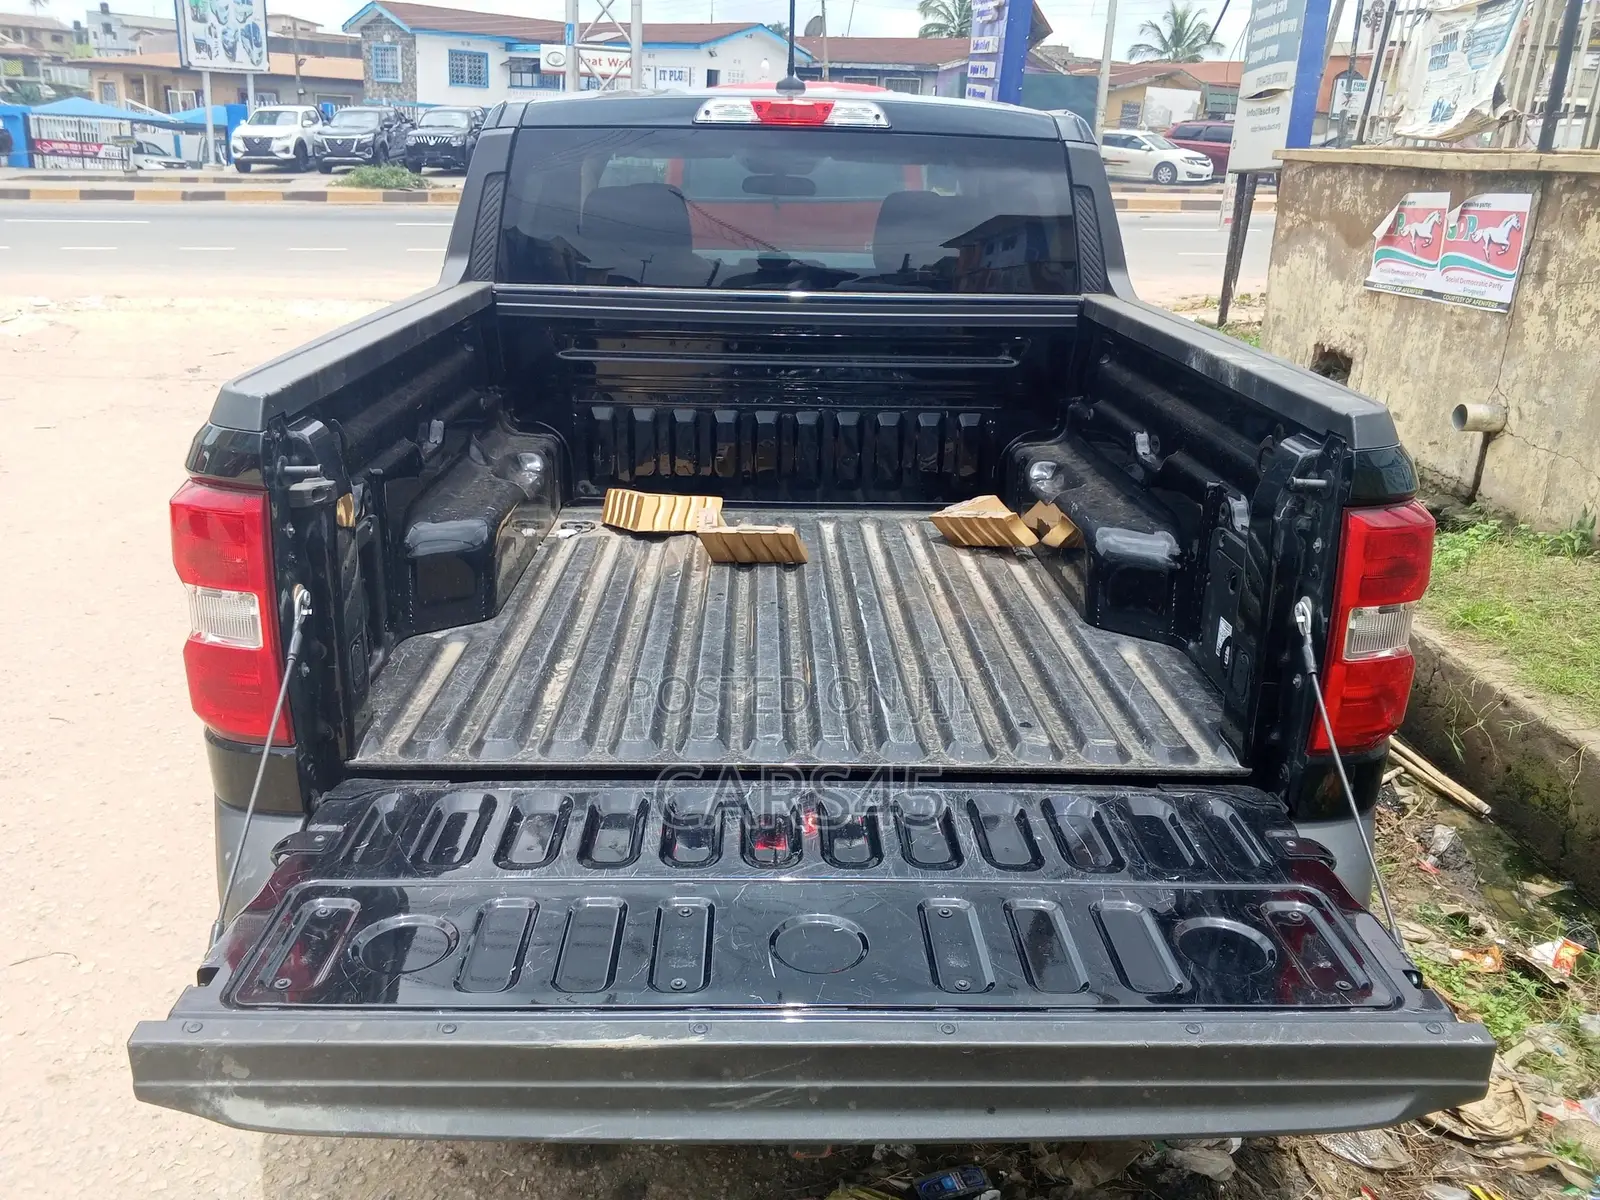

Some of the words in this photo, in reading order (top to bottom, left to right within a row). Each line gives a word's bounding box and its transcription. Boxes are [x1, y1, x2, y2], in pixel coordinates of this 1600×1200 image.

[1445, 275, 1460, 284] Social
[1460, 278, 1489, 288] Democratic
[1488, 281, 1503, 291] Party
[1442, 294, 1465, 303] COURTESY
